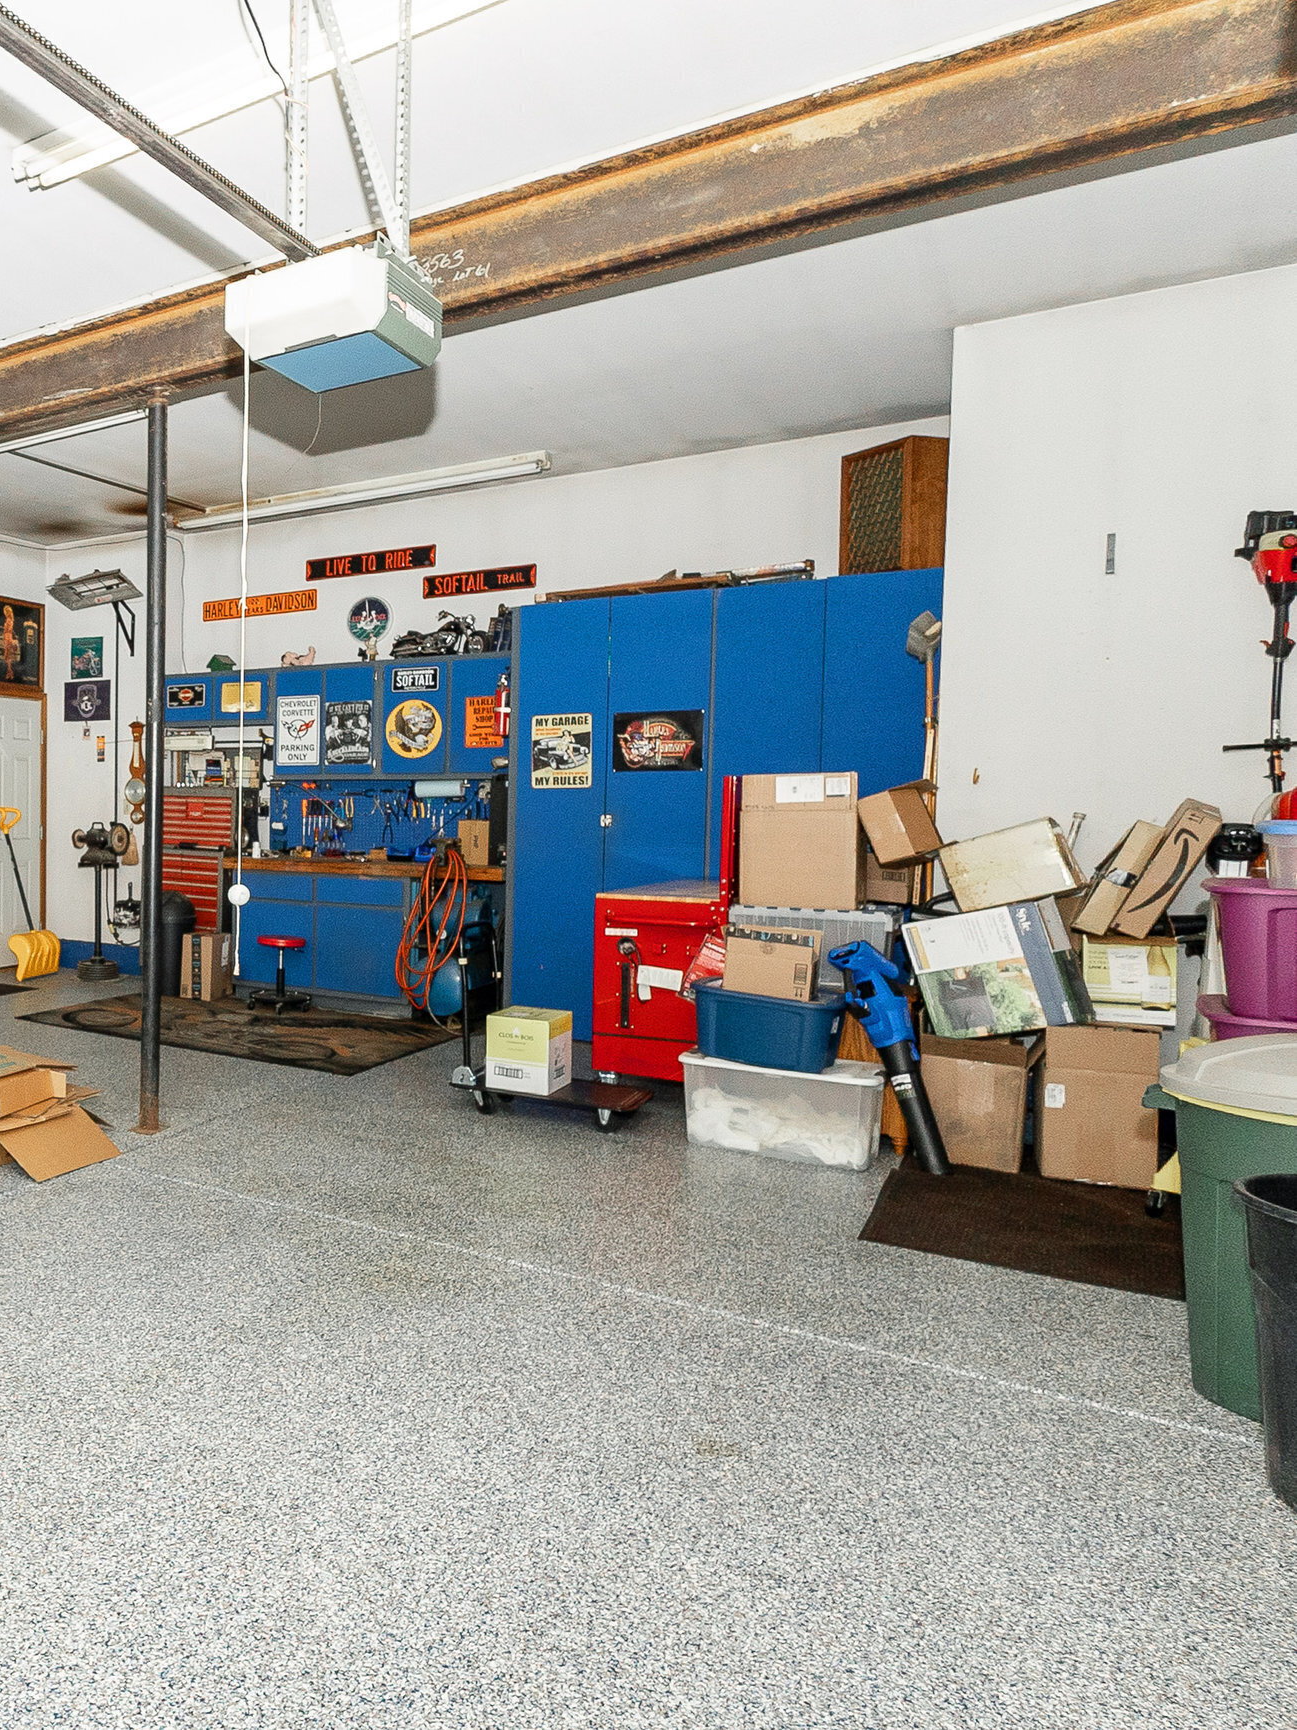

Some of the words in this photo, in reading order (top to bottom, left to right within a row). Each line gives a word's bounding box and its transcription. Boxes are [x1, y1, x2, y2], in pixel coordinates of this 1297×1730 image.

[325, 557, 352, 577] LIVE
[361, 555, 377, 573] TO
[385, 550, 414, 570] RIDE
[434, 573, 488, 596] SOFTAIL
[497, 571, 525, 585] TRAIL
[205, 601, 240, 619] HARLEY
[265, 592, 315, 612] DAVIDSON
[395, 674, 435, 688] SOFTAIL
[280, 700, 317, 708] CHEVROLET
[469, 698, 497, 707] HARLE
[282, 708, 315, 717] CORVETTE
[535, 717, 549, 727] MY
[552, 716, 590, 727] GARAGE
[280, 744, 315, 752] PARKING
[287, 753, 308, 761] ONLY
[535, 777, 550, 786] MY
[553, 776, 589, 786] RULES!
